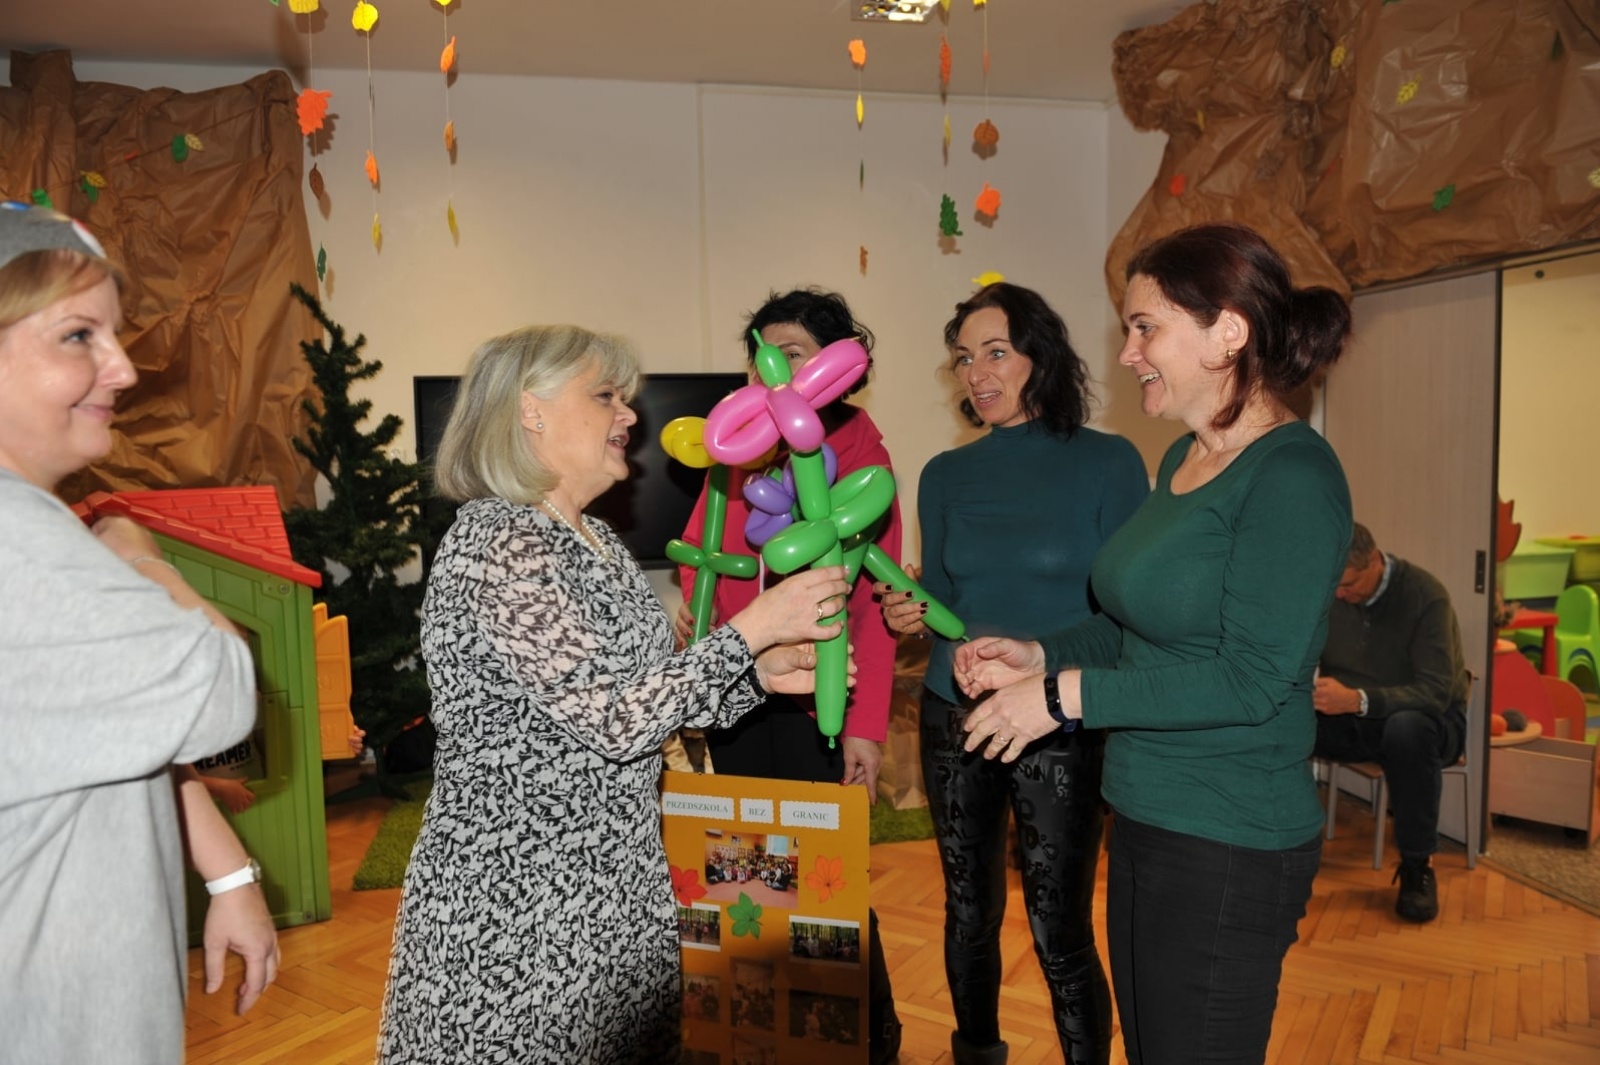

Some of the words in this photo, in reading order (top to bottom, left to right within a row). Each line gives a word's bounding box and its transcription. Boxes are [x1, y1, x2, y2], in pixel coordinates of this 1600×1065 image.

[666, 800, 729, 813] PRZEDSZKOLA
[748, 807, 767, 817] BEZ
[792, 810, 831, 821] GRANIC
